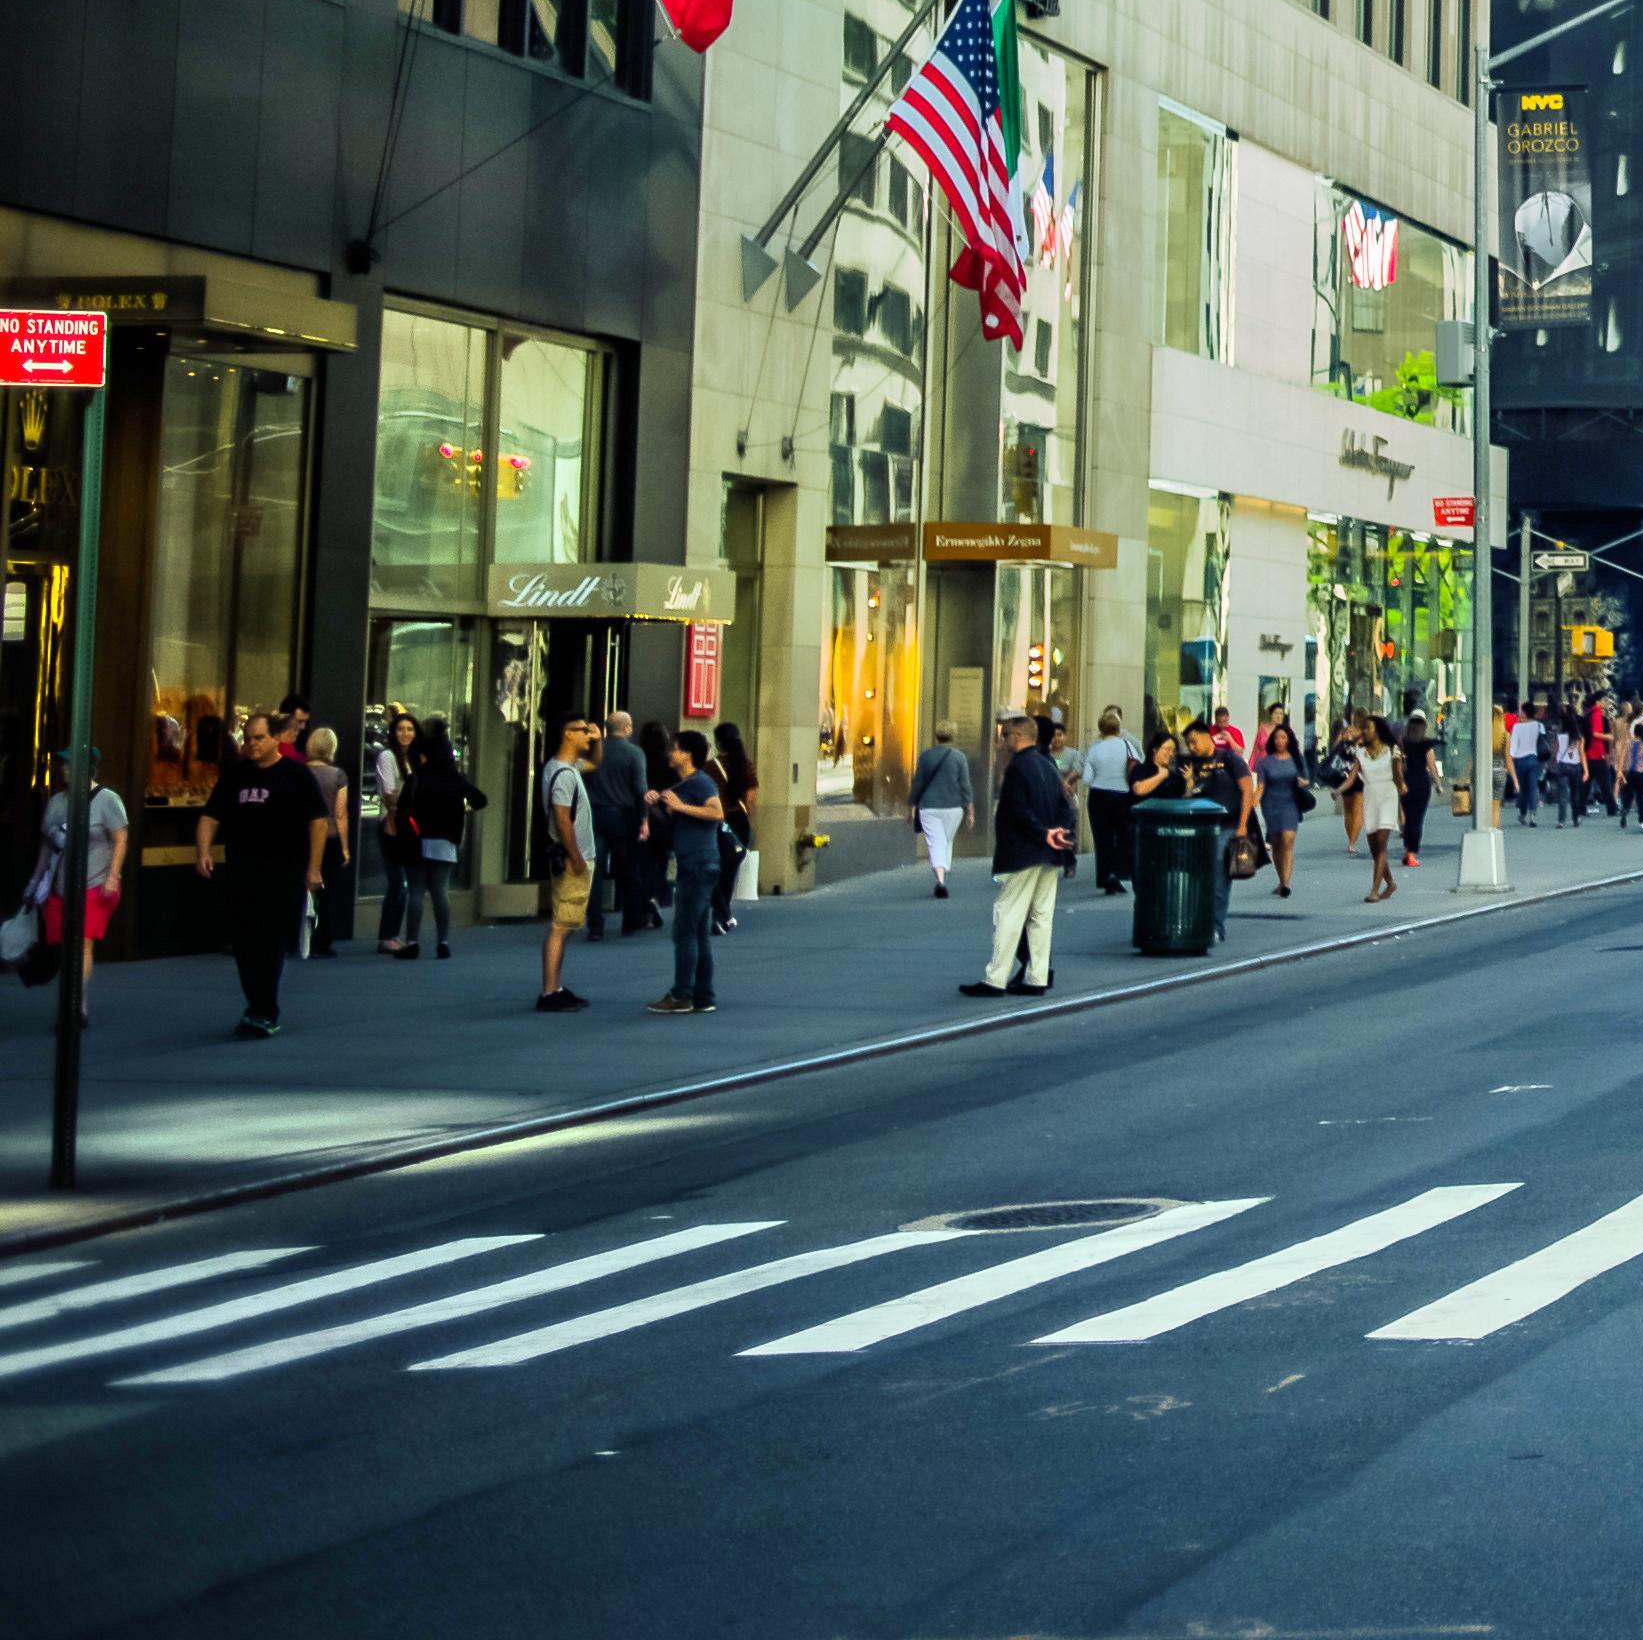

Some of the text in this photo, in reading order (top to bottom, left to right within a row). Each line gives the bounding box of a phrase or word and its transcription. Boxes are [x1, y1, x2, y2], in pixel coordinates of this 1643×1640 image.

[1521, 94, 1564, 111] NYC
[1507, 121, 1578, 138] GABRIEL
[1507, 137, 1579, 154] OROZCO
[77, 295, 147, 309] ROLEX
[0, 318, 99, 335] NO STANDING
[10, 338, 87, 355] ANYTIME
[935, 534, 1042, 548] Ermenegildo Zegna
[498, 572, 602, 608] Lindt
[663, 575, 703, 610] Lindt
[239, 787, 270, 804] GAP
